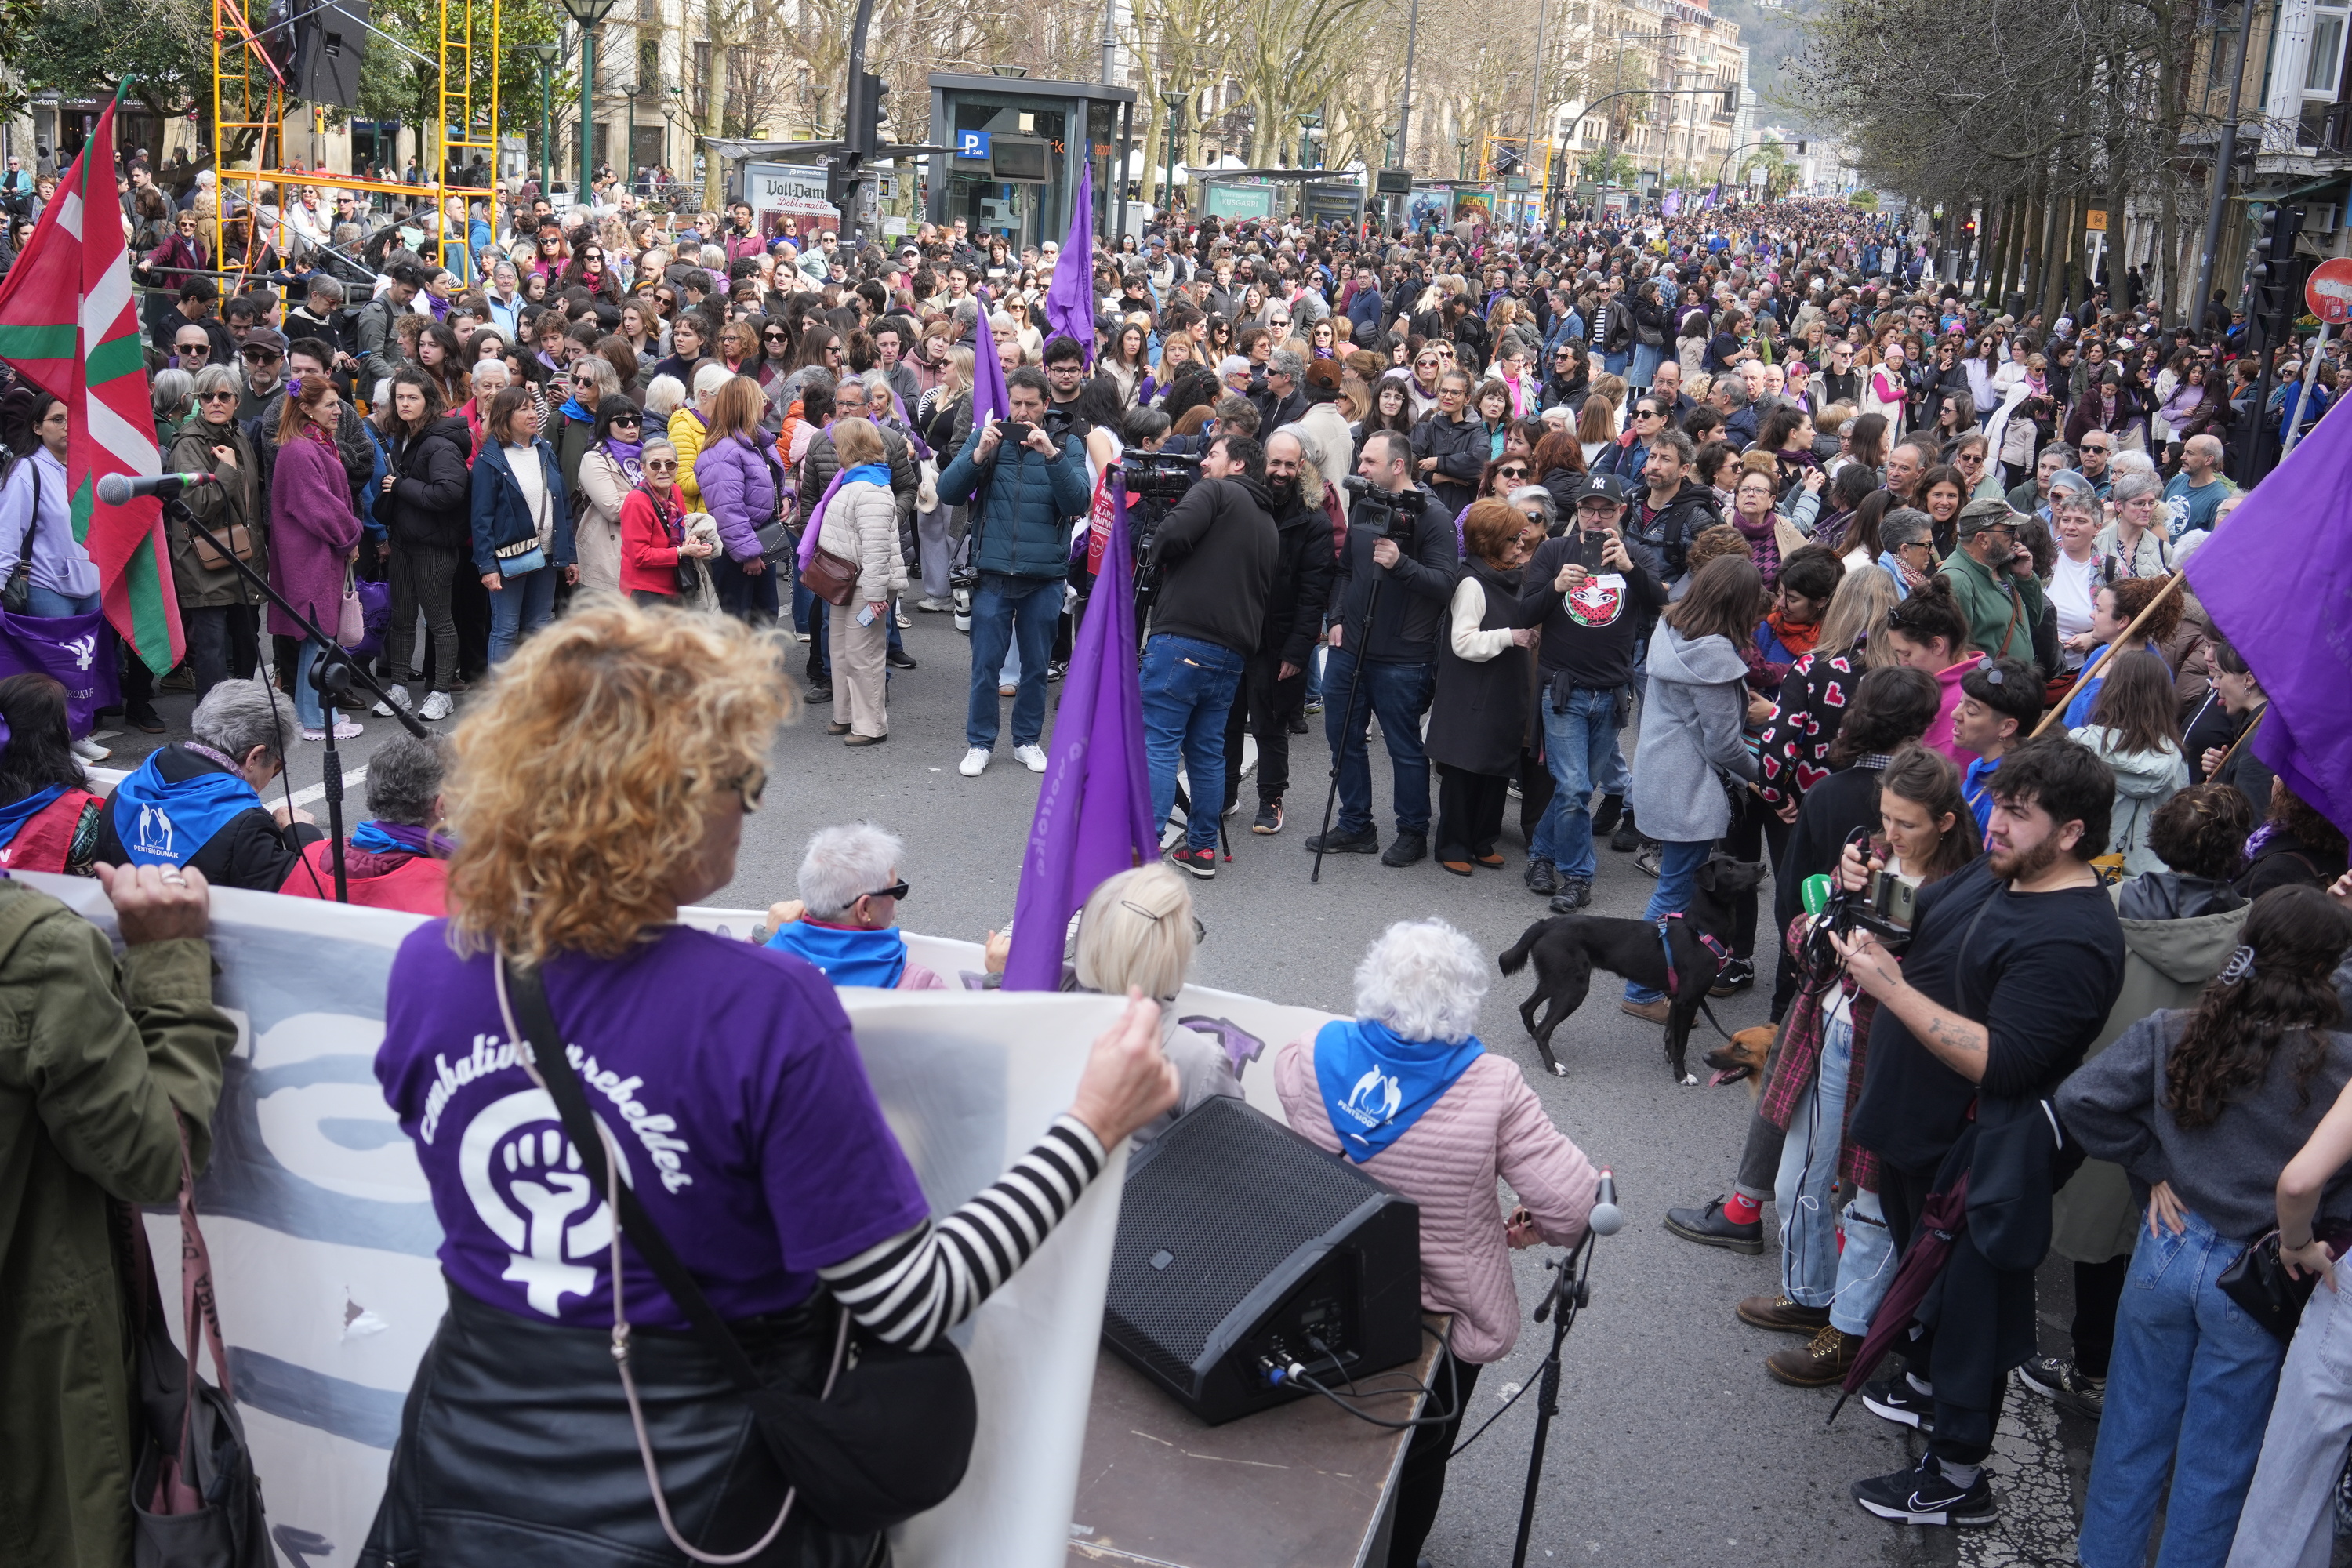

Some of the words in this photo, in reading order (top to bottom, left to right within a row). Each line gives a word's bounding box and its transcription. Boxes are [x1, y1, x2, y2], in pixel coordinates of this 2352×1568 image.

[965, 134, 979, 154] P
[1094, 142, 1113, 158] telpark
[777, 198, 804, 208] Doble
[804, 199, 829, 210] malta
[1220, 198, 1258, 208] IKUSGARRI
[1459, 194, 1490, 207] IMPACTA
[1591, 477, 1606, 490] NY
[1094, 503, 1116, 521] ALARI
[419, 1032, 538, 1146] combativa
[582, 1054, 694, 1195] rebeldes
